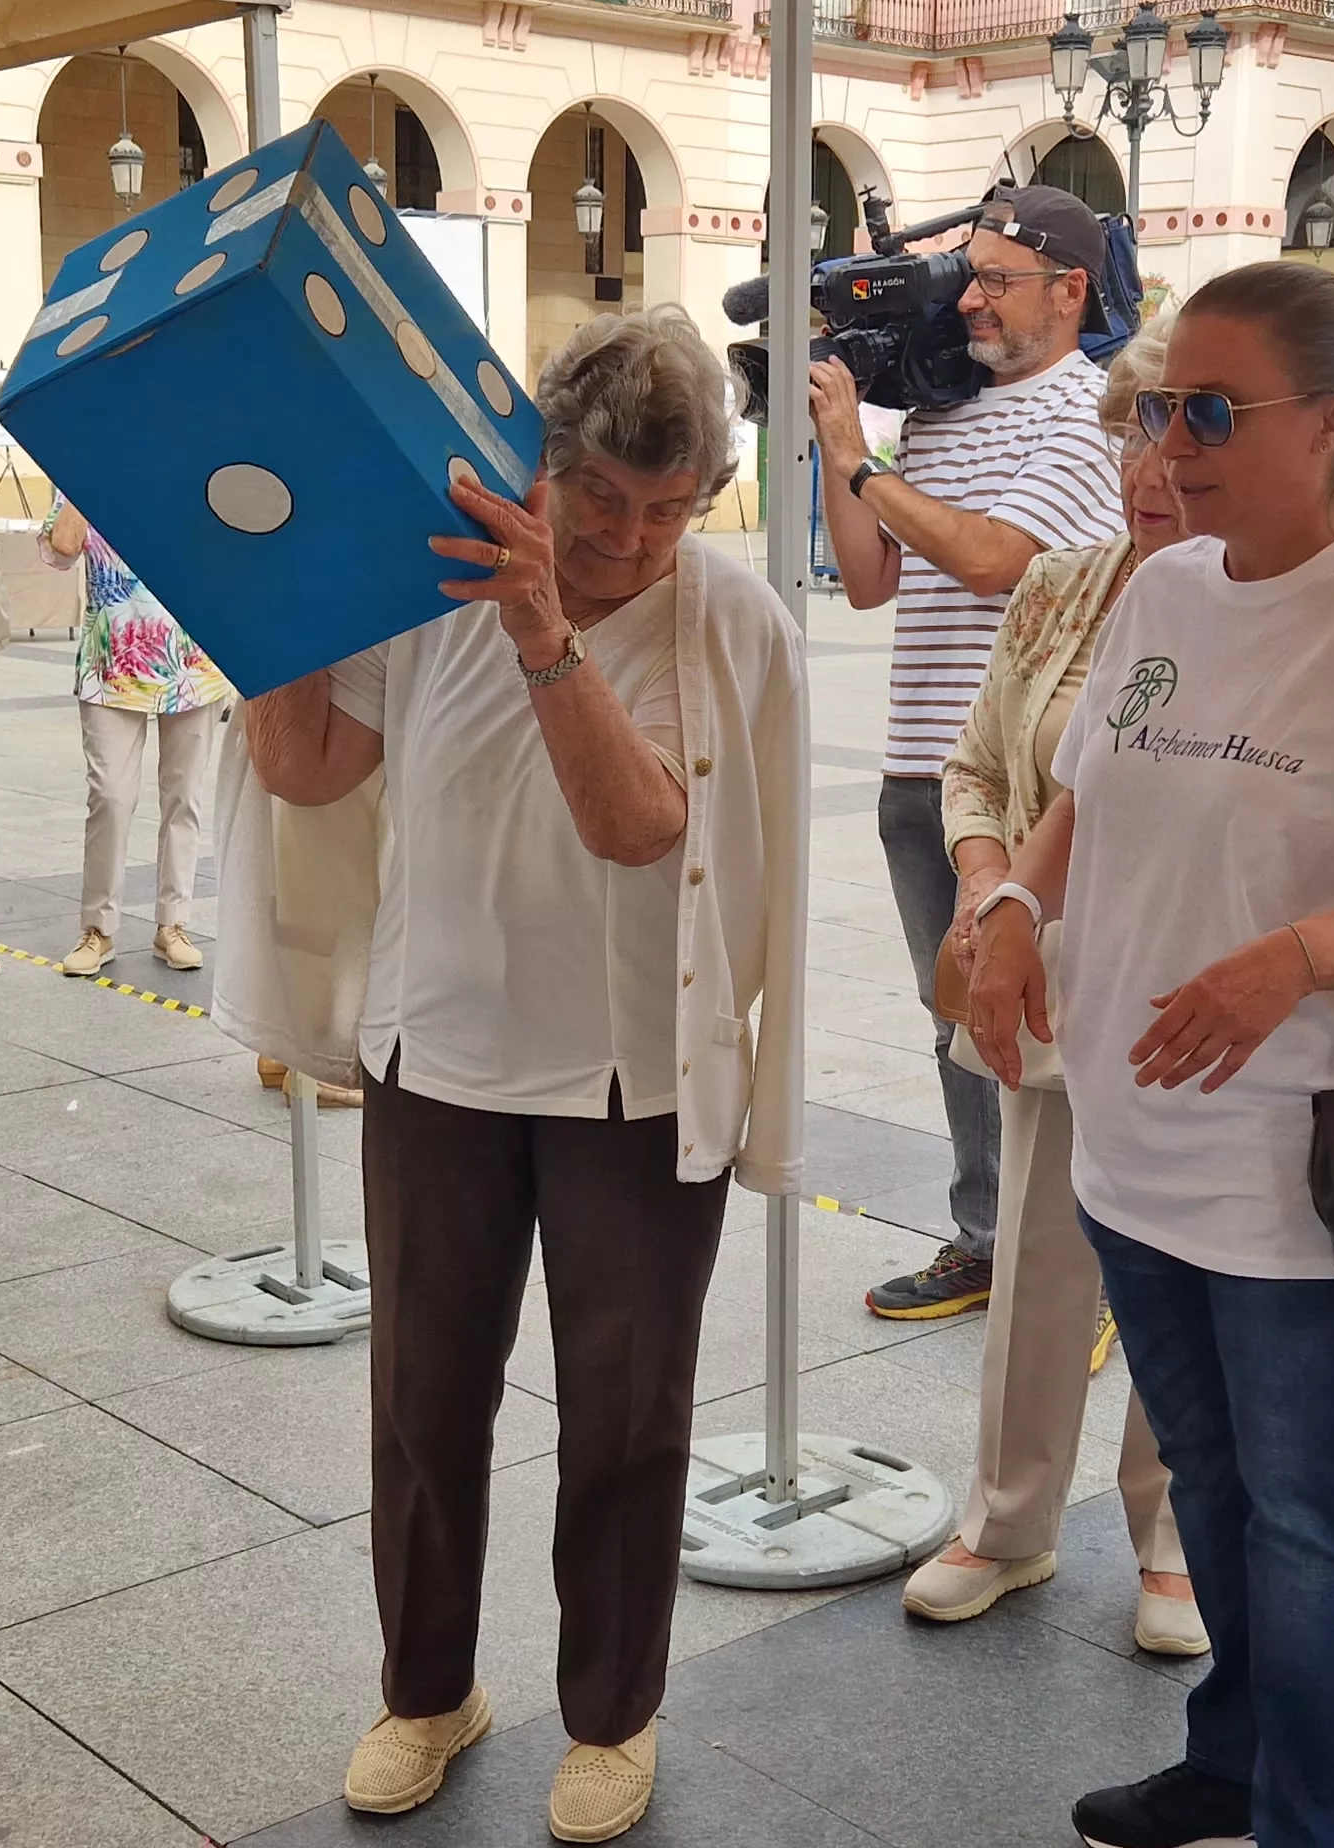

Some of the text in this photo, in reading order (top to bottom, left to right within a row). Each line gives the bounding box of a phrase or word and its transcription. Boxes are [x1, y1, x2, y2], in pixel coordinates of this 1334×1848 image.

[872, 276, 906, 288] ARAGÓN
[872, 288, 884, 297] TV
[1128, 724, 1306, 775] Alzheimer Huesca
